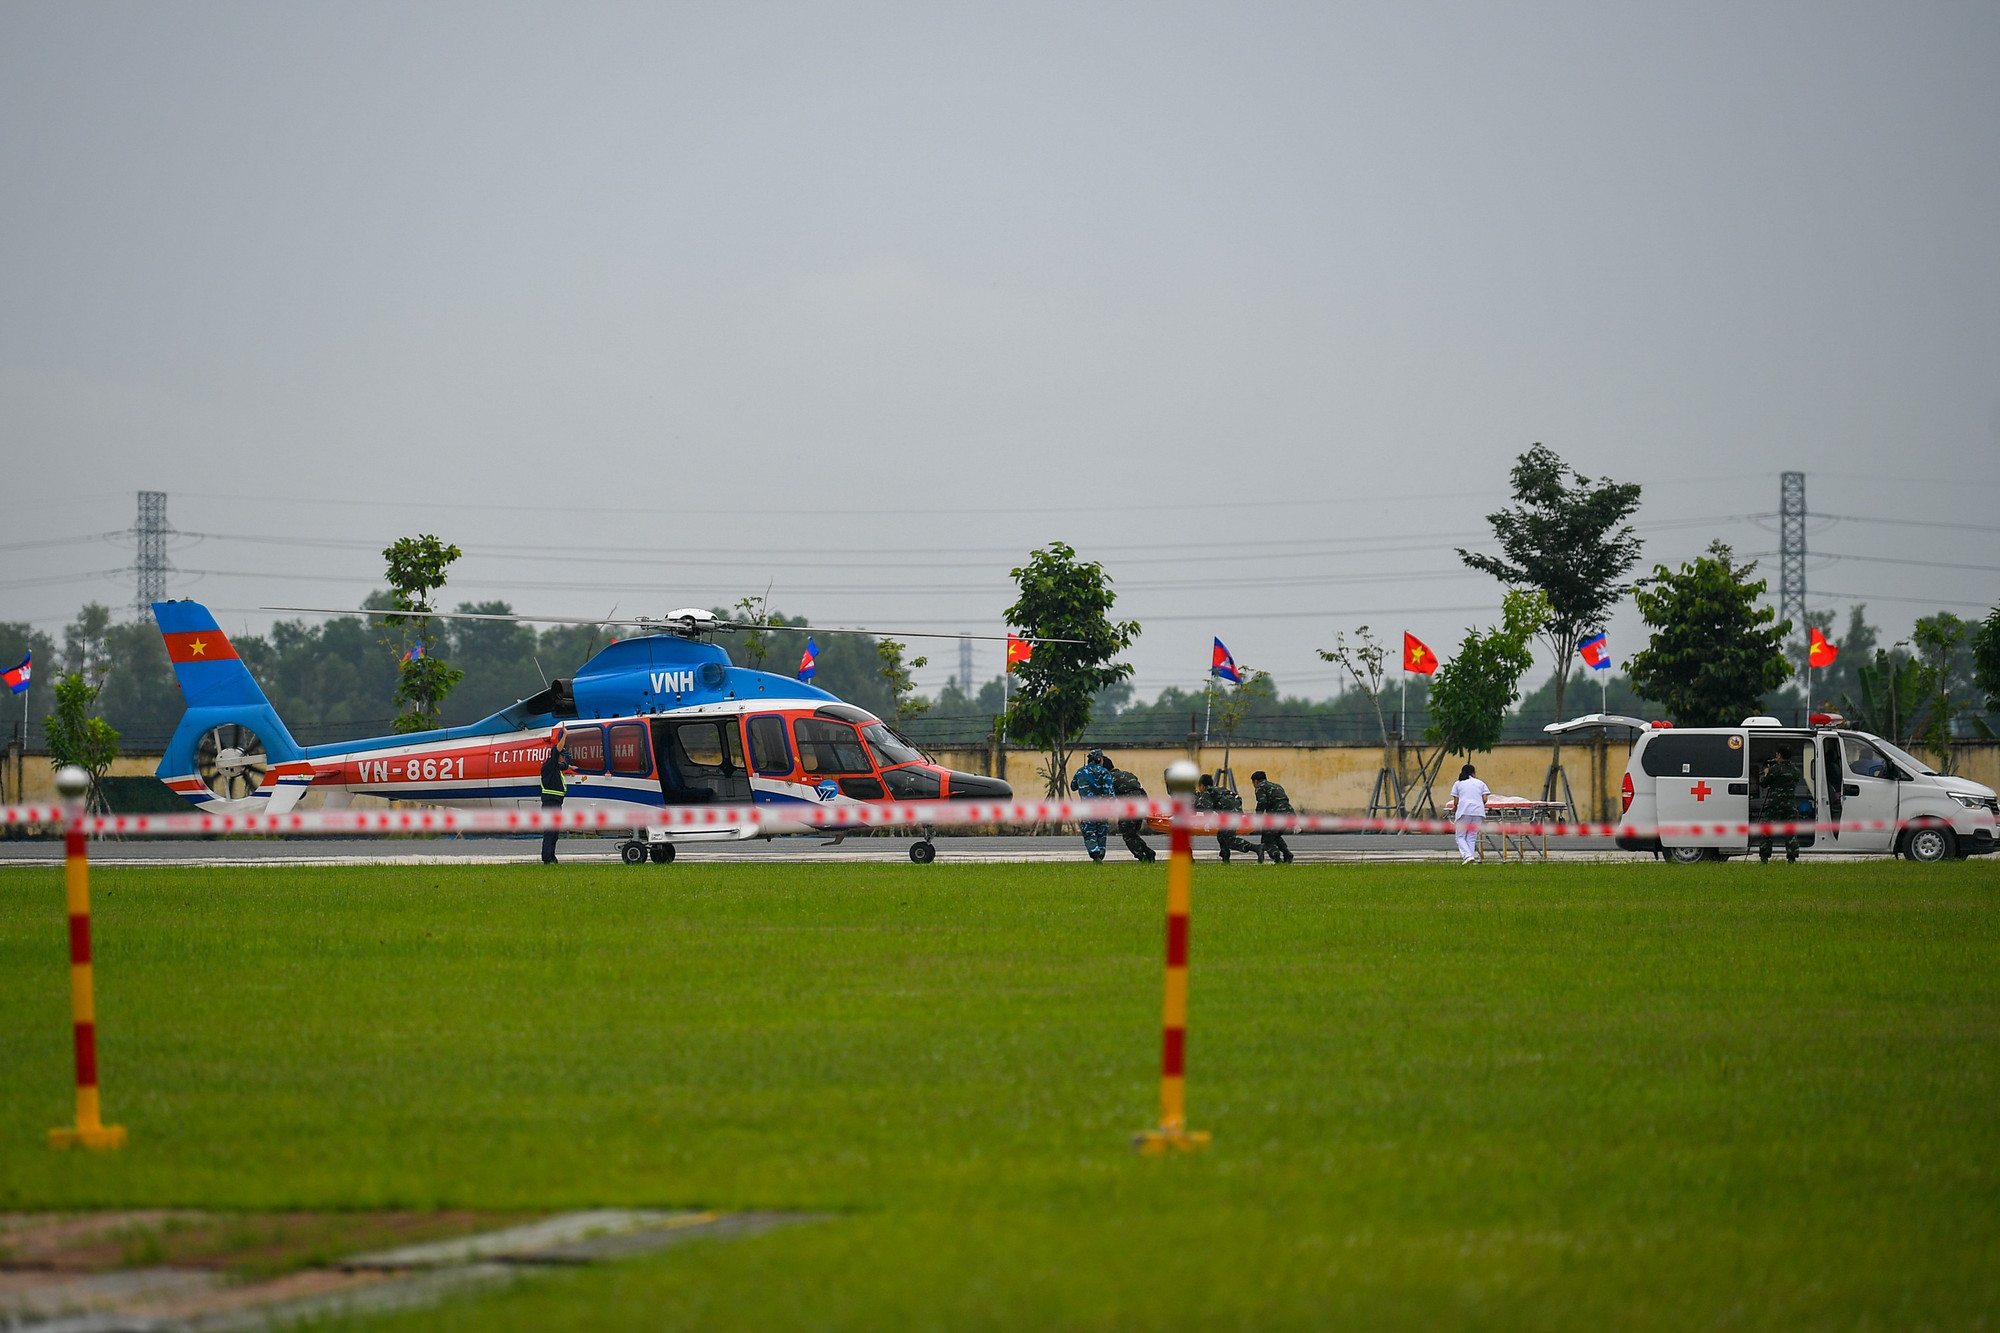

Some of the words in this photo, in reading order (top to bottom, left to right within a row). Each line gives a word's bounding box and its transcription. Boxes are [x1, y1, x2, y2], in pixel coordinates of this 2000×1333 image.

[650, 671, 694, 694] VNH
[494, 749, 524, 764] T.C.TY
[590, 742, 604, 761] VIỆ
[615, 744, 634, 757] NAM
[358, 757, 465, 783] VN-8621
